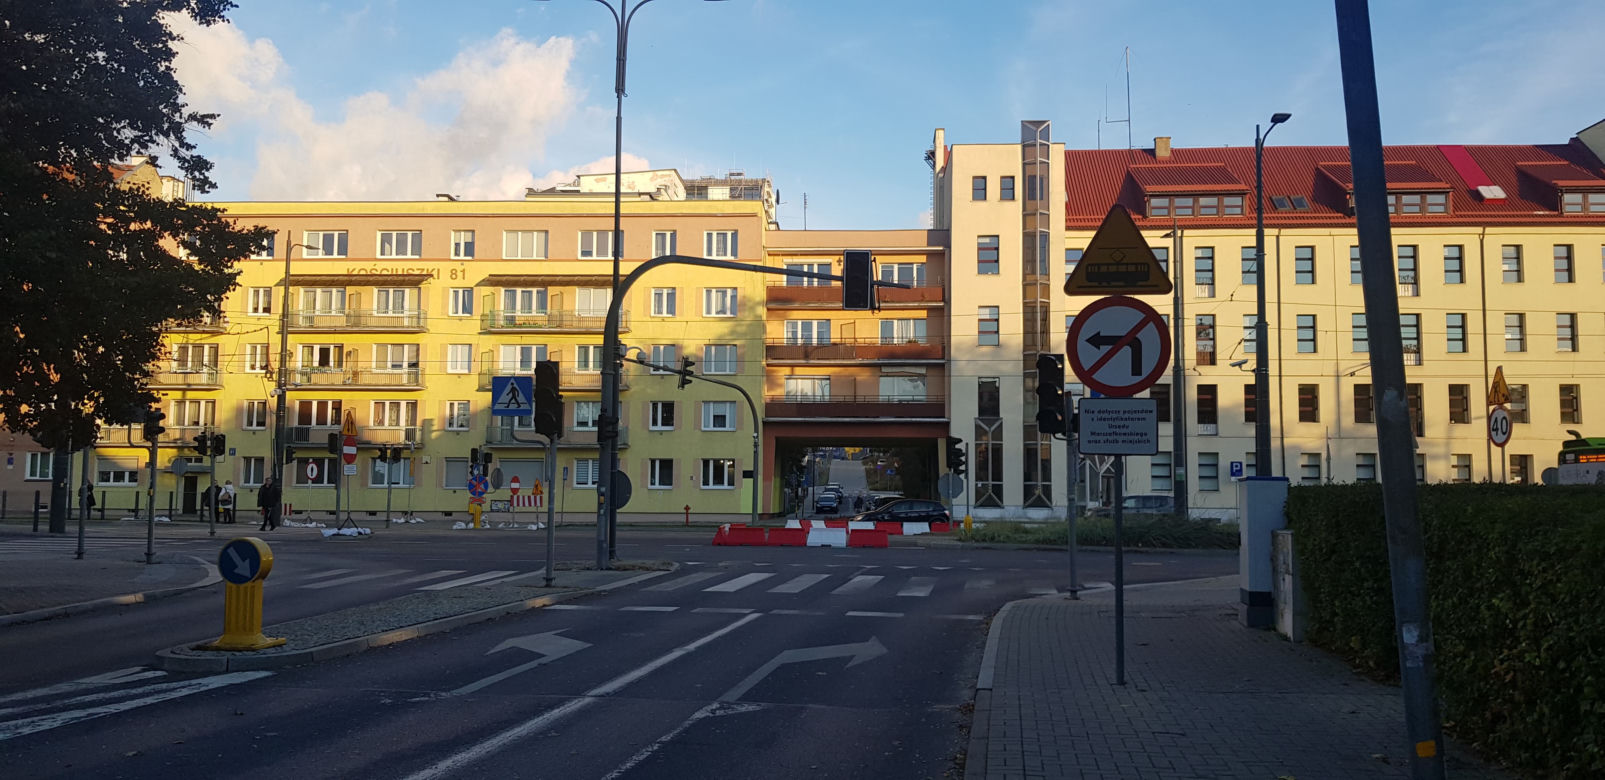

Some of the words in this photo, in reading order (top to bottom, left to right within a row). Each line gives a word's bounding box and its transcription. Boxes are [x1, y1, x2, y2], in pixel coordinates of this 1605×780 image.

[347, 264, 440, 280] KOŚCIUSZKI
[450, 268, 466, 280] 81
[1492, 416, 1508, 436] 40
[1233, 463, 1240, 472] P
